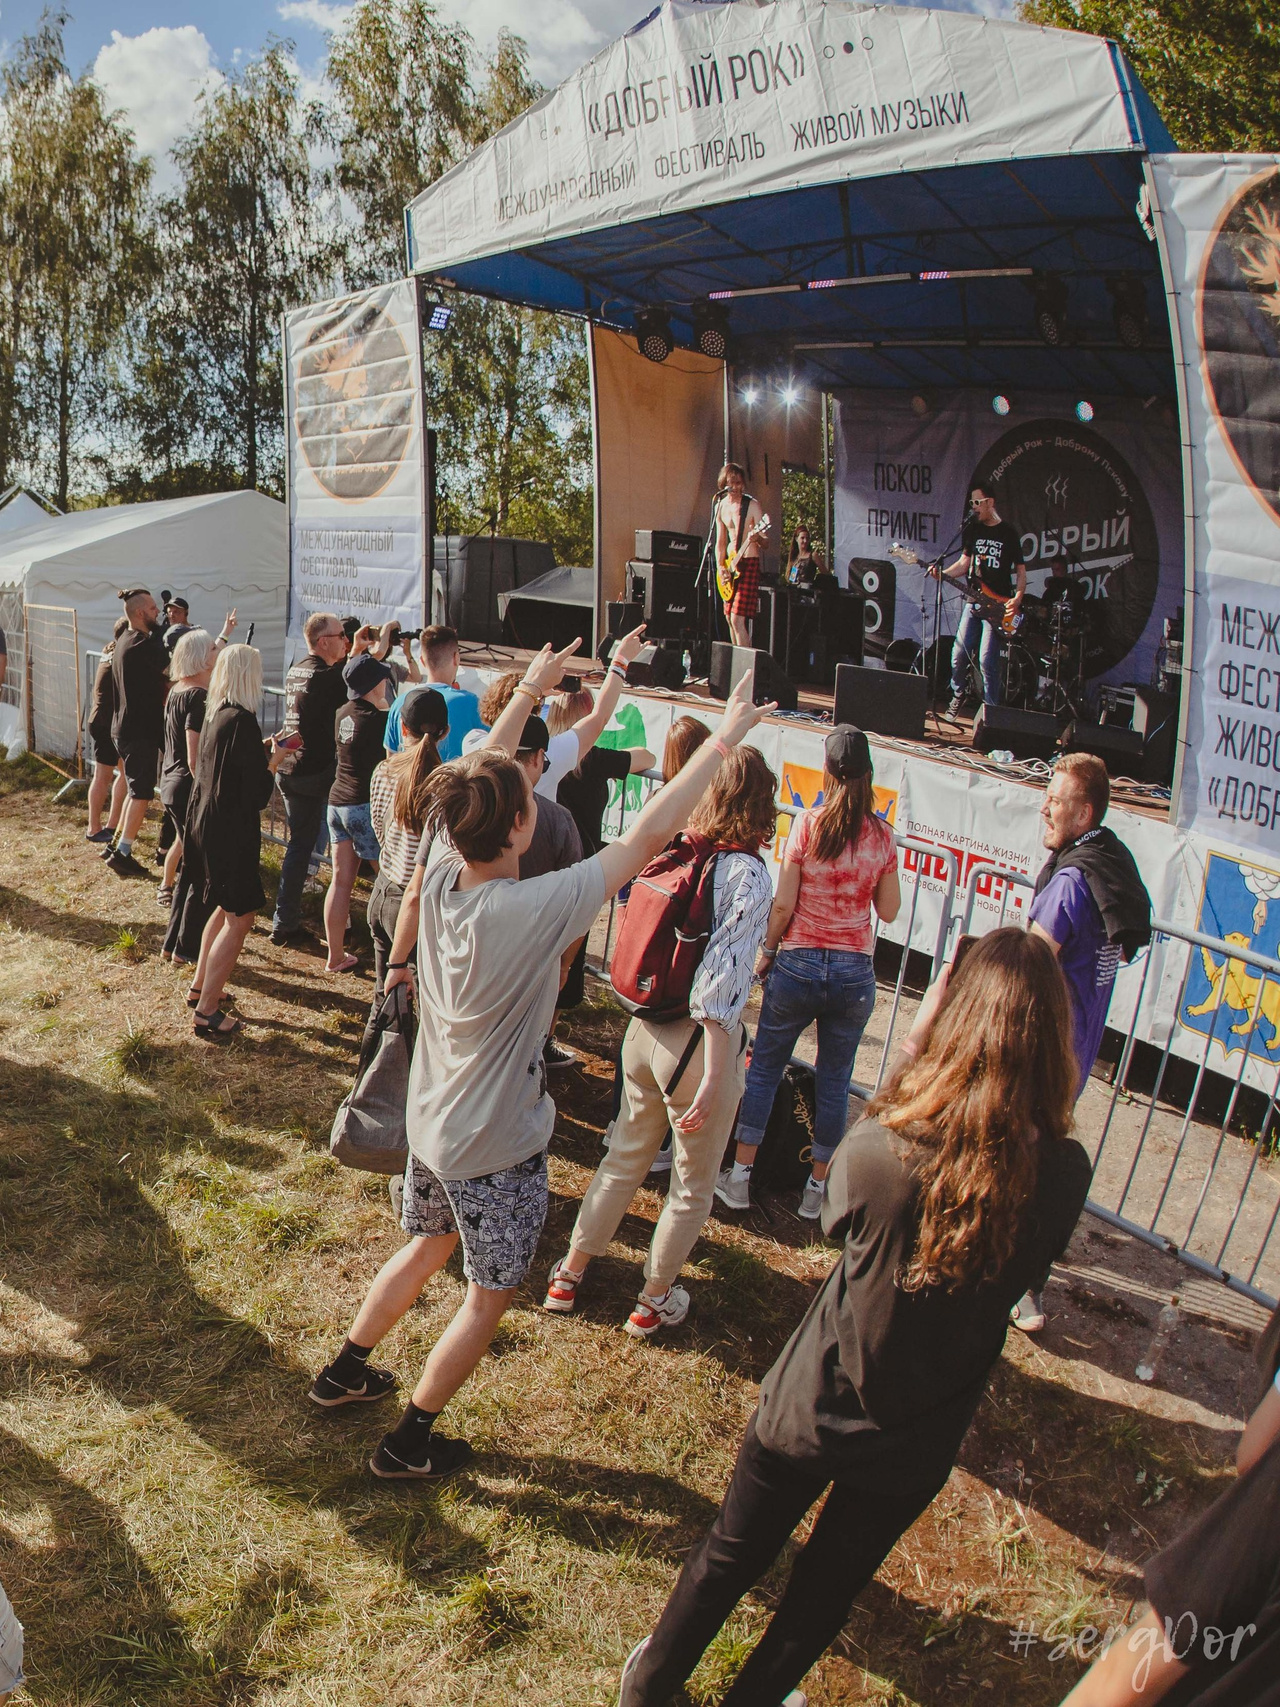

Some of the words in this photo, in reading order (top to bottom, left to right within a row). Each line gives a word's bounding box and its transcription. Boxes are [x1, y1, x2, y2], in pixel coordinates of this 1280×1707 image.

[728, 42, 805, 100] РОК»
[493, 157, 636, 222] МЕЖДУНАРОДНЫЙ
[654, 132, 765, 180] ФЕСТИВАЛЬ
[790, 104, 865, 152] ЖИВОЙ
[870, 91, 970, 136] МУЗЫКИ
[1024, 438, 1043, 450] Рок
[1055, 436, 1100, 463] Доброму
[874, 462, 932, 494] ПСКОВ
[300, 526, 394, 552] МЕЖДУНАРОДНЫЙ
[868, 508, 940, 544] ПРИМЕТ
[1019, 508, 1130, 562] ОБРЫЙ
[300, 556, 358, 578] ФЕСТИВАЛЬ
[300, 582, 335, 605] ЖИВОЙ
[338, 586, 381, 609] МУЗЫКИ
[906, 820, 945, 840] ПОЛНАЯ
[946, 832, 990, 853] КАРТИНА
[991, 845, 1031, 866] ЖИЗНИ!
[976, 899, 1021, 922] НОВОТЕЙ
